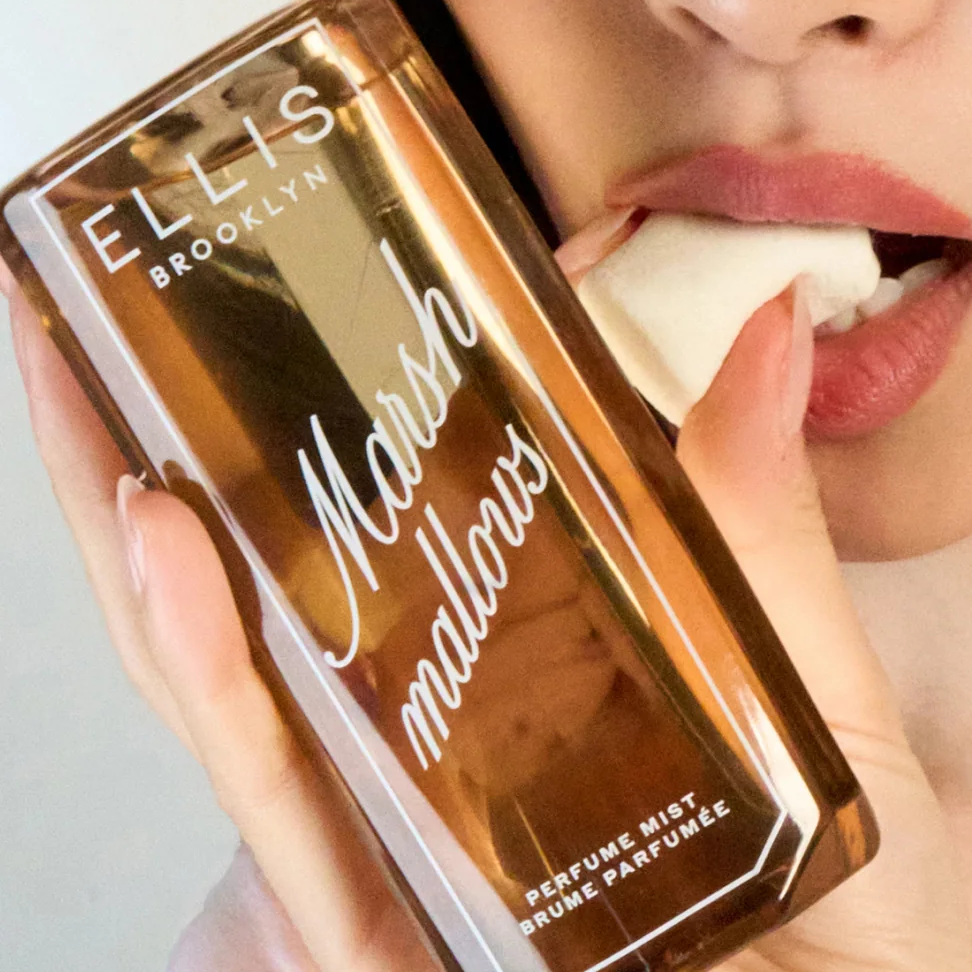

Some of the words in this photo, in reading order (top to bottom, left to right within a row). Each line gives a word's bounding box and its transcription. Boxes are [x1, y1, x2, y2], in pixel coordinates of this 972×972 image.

[81, 85, 335, 274] ELLIS
[149, 164, 329, 289] BROOKLYN
[298, 238, 478, 668] Marsh
[400, 423, 549, 771] mallows
[518, 883, 598, 936] BRUME
[602, 799, 731, 886] PARFUMÉE
[525, 832, 635, 906] PERFUME
[639, 792, 696, 837] MIST
